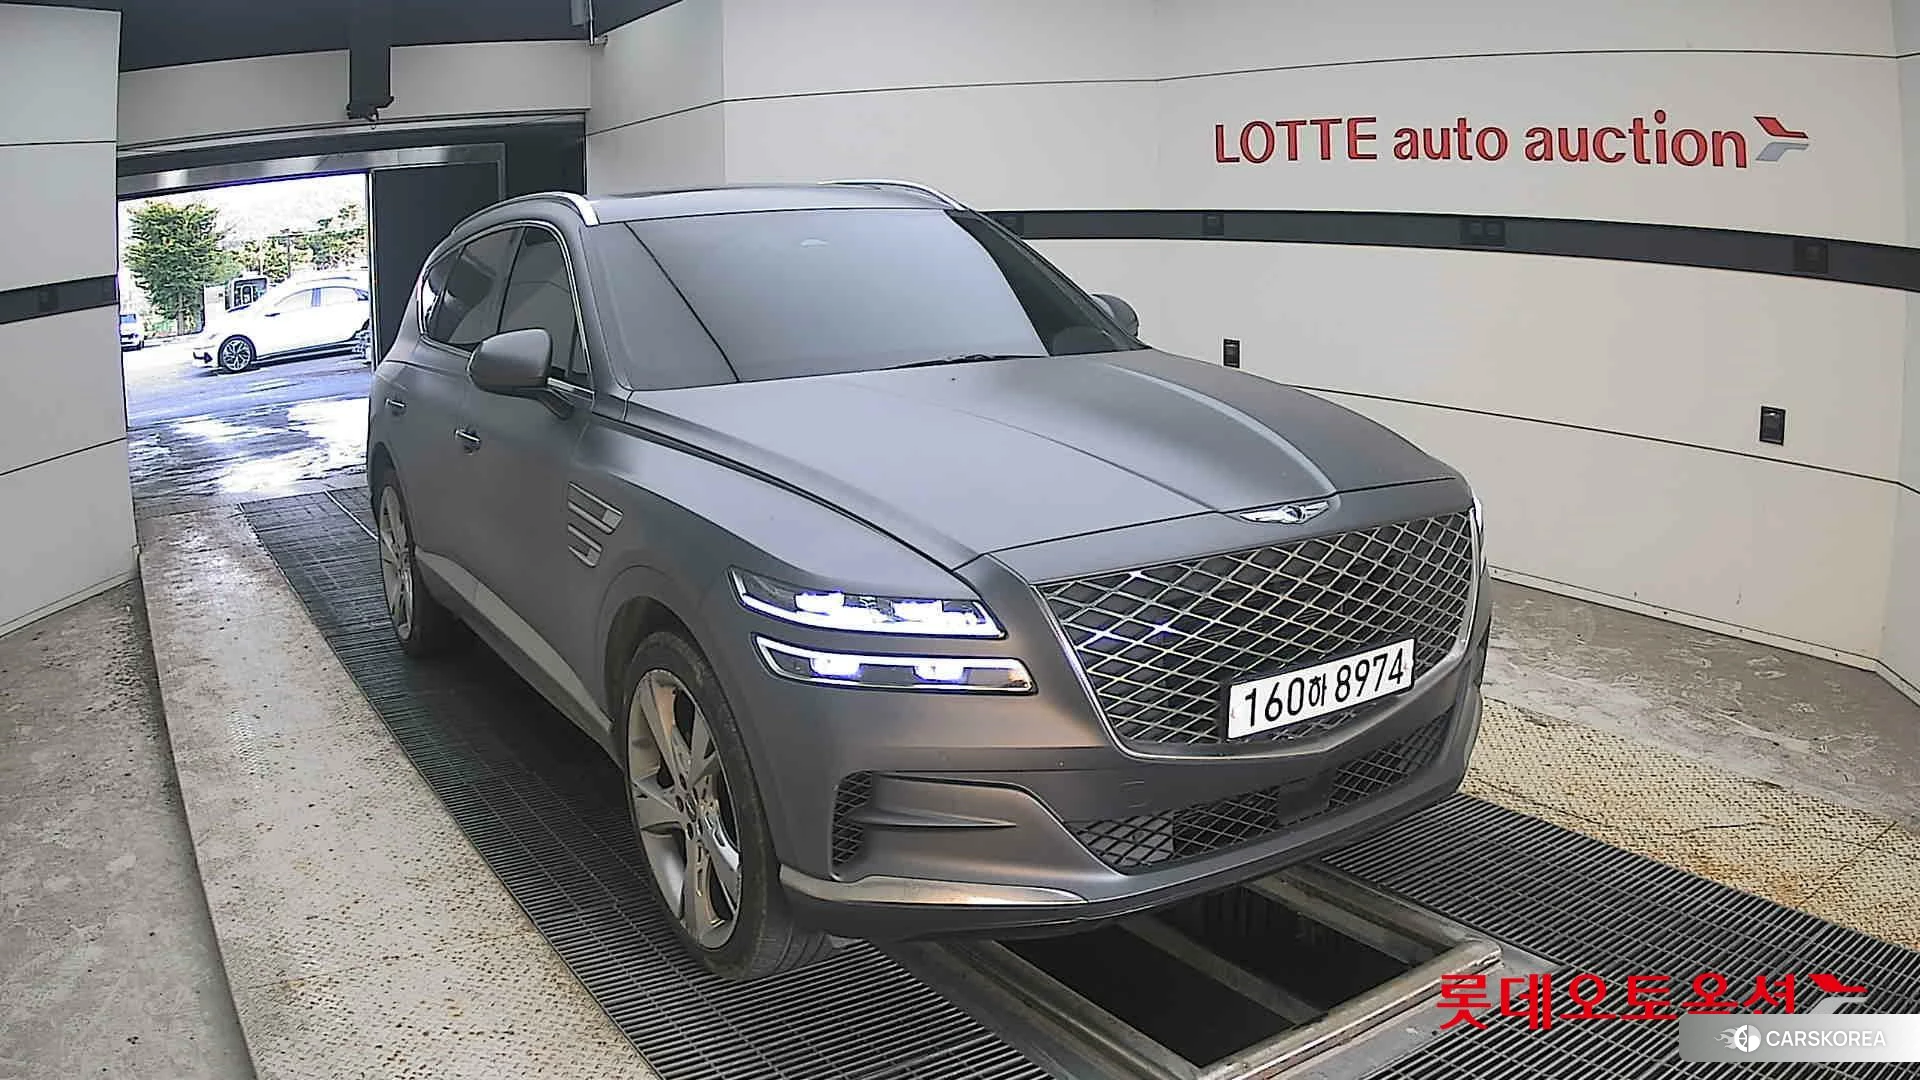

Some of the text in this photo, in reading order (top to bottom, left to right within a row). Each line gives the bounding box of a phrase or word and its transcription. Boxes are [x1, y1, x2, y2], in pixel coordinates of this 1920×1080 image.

[1215, 109, 1748, 169] LOTTE auto auction
